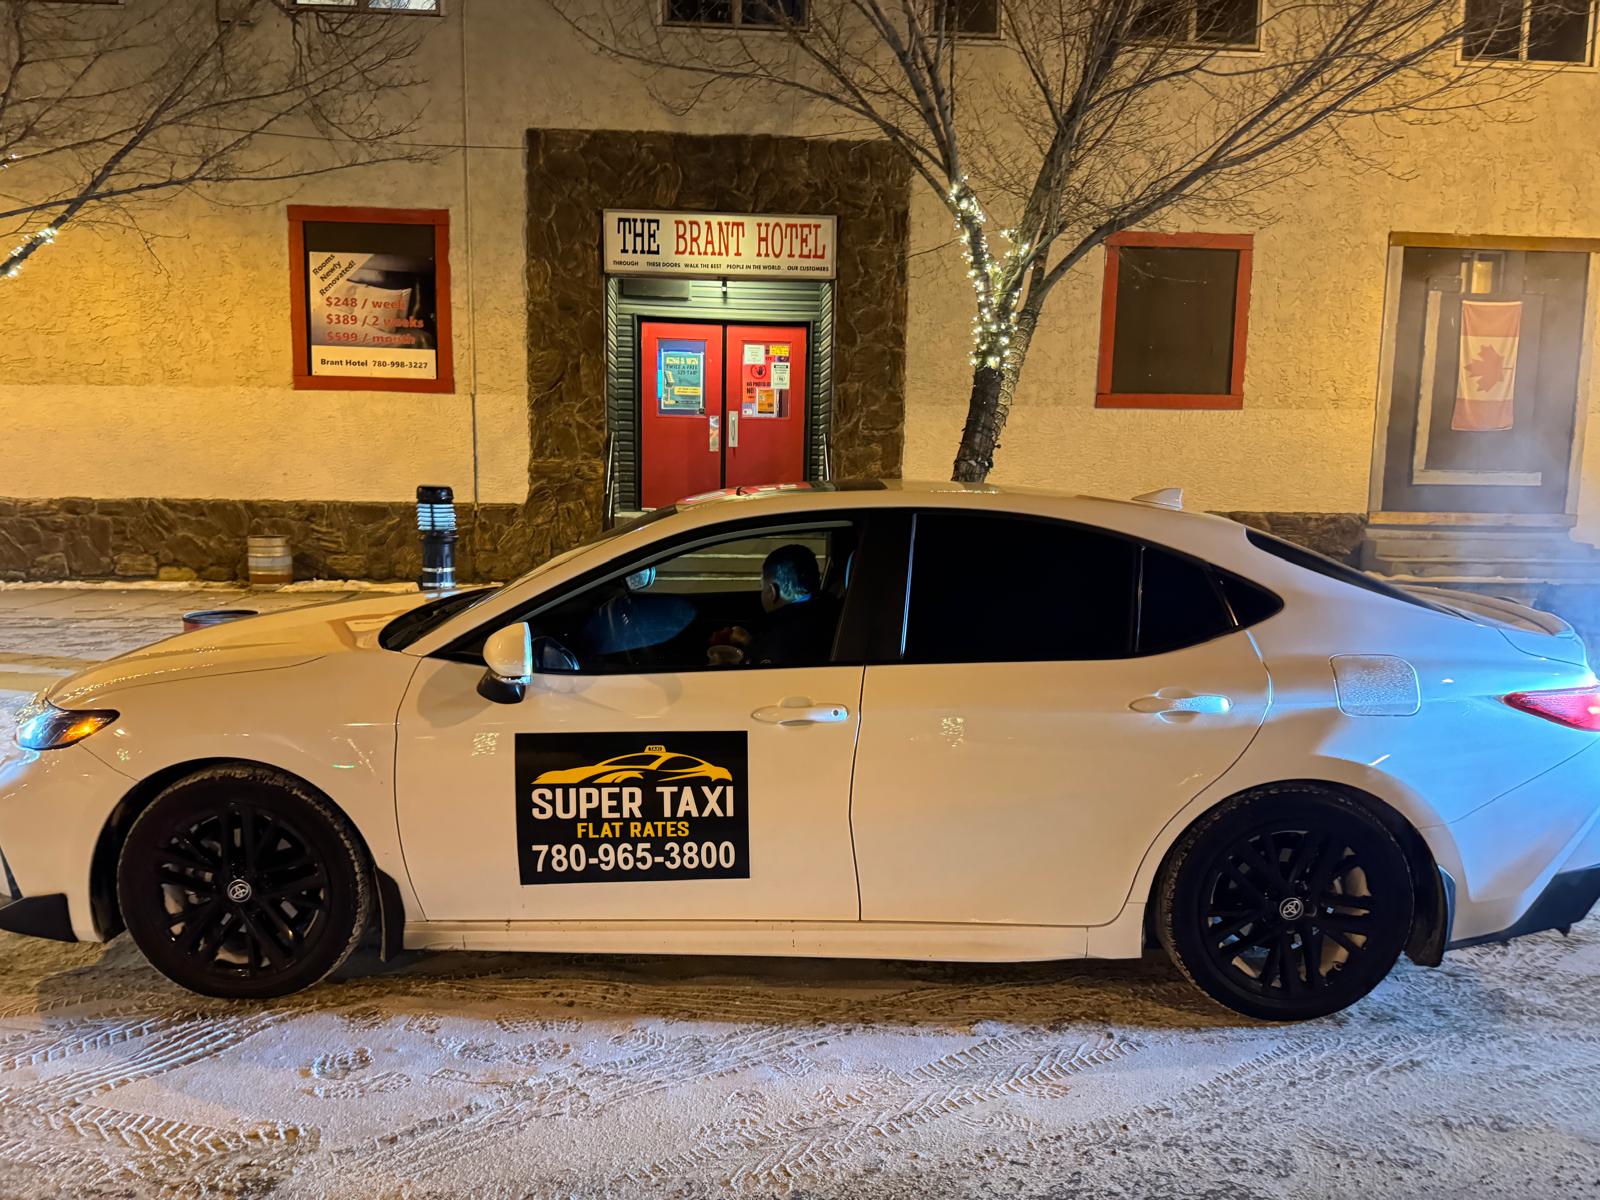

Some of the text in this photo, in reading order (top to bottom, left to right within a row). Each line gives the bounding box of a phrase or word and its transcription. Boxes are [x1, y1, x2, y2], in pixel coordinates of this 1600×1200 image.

[617, 217, 826, 260] THE BRANT HOTEL
[312, 254, 336, 276] Rooms
[319, 261, 342, 282] Newly
[661, 261, 681, 269] DOORS
[319, 259, 357, 296] Renovated!
[325, 296, 358, 308] $248
[371, 297, 407, 310] week
[325, 313, 358, 325] $389
[371, 316, 380, 326] 2
[383, 315, 424, 328] weeks
[326, 331, 358, 342] $599
[372, 333, 416, 345] month
[320, 358, 428, 369] Brant Hotel 780-998-3227
[531, 785, 735, 820] SUPER TAXI
[576, 821, 690, 839] FLAT RATES
[531, 840, 736, 873] 780-965-3800
